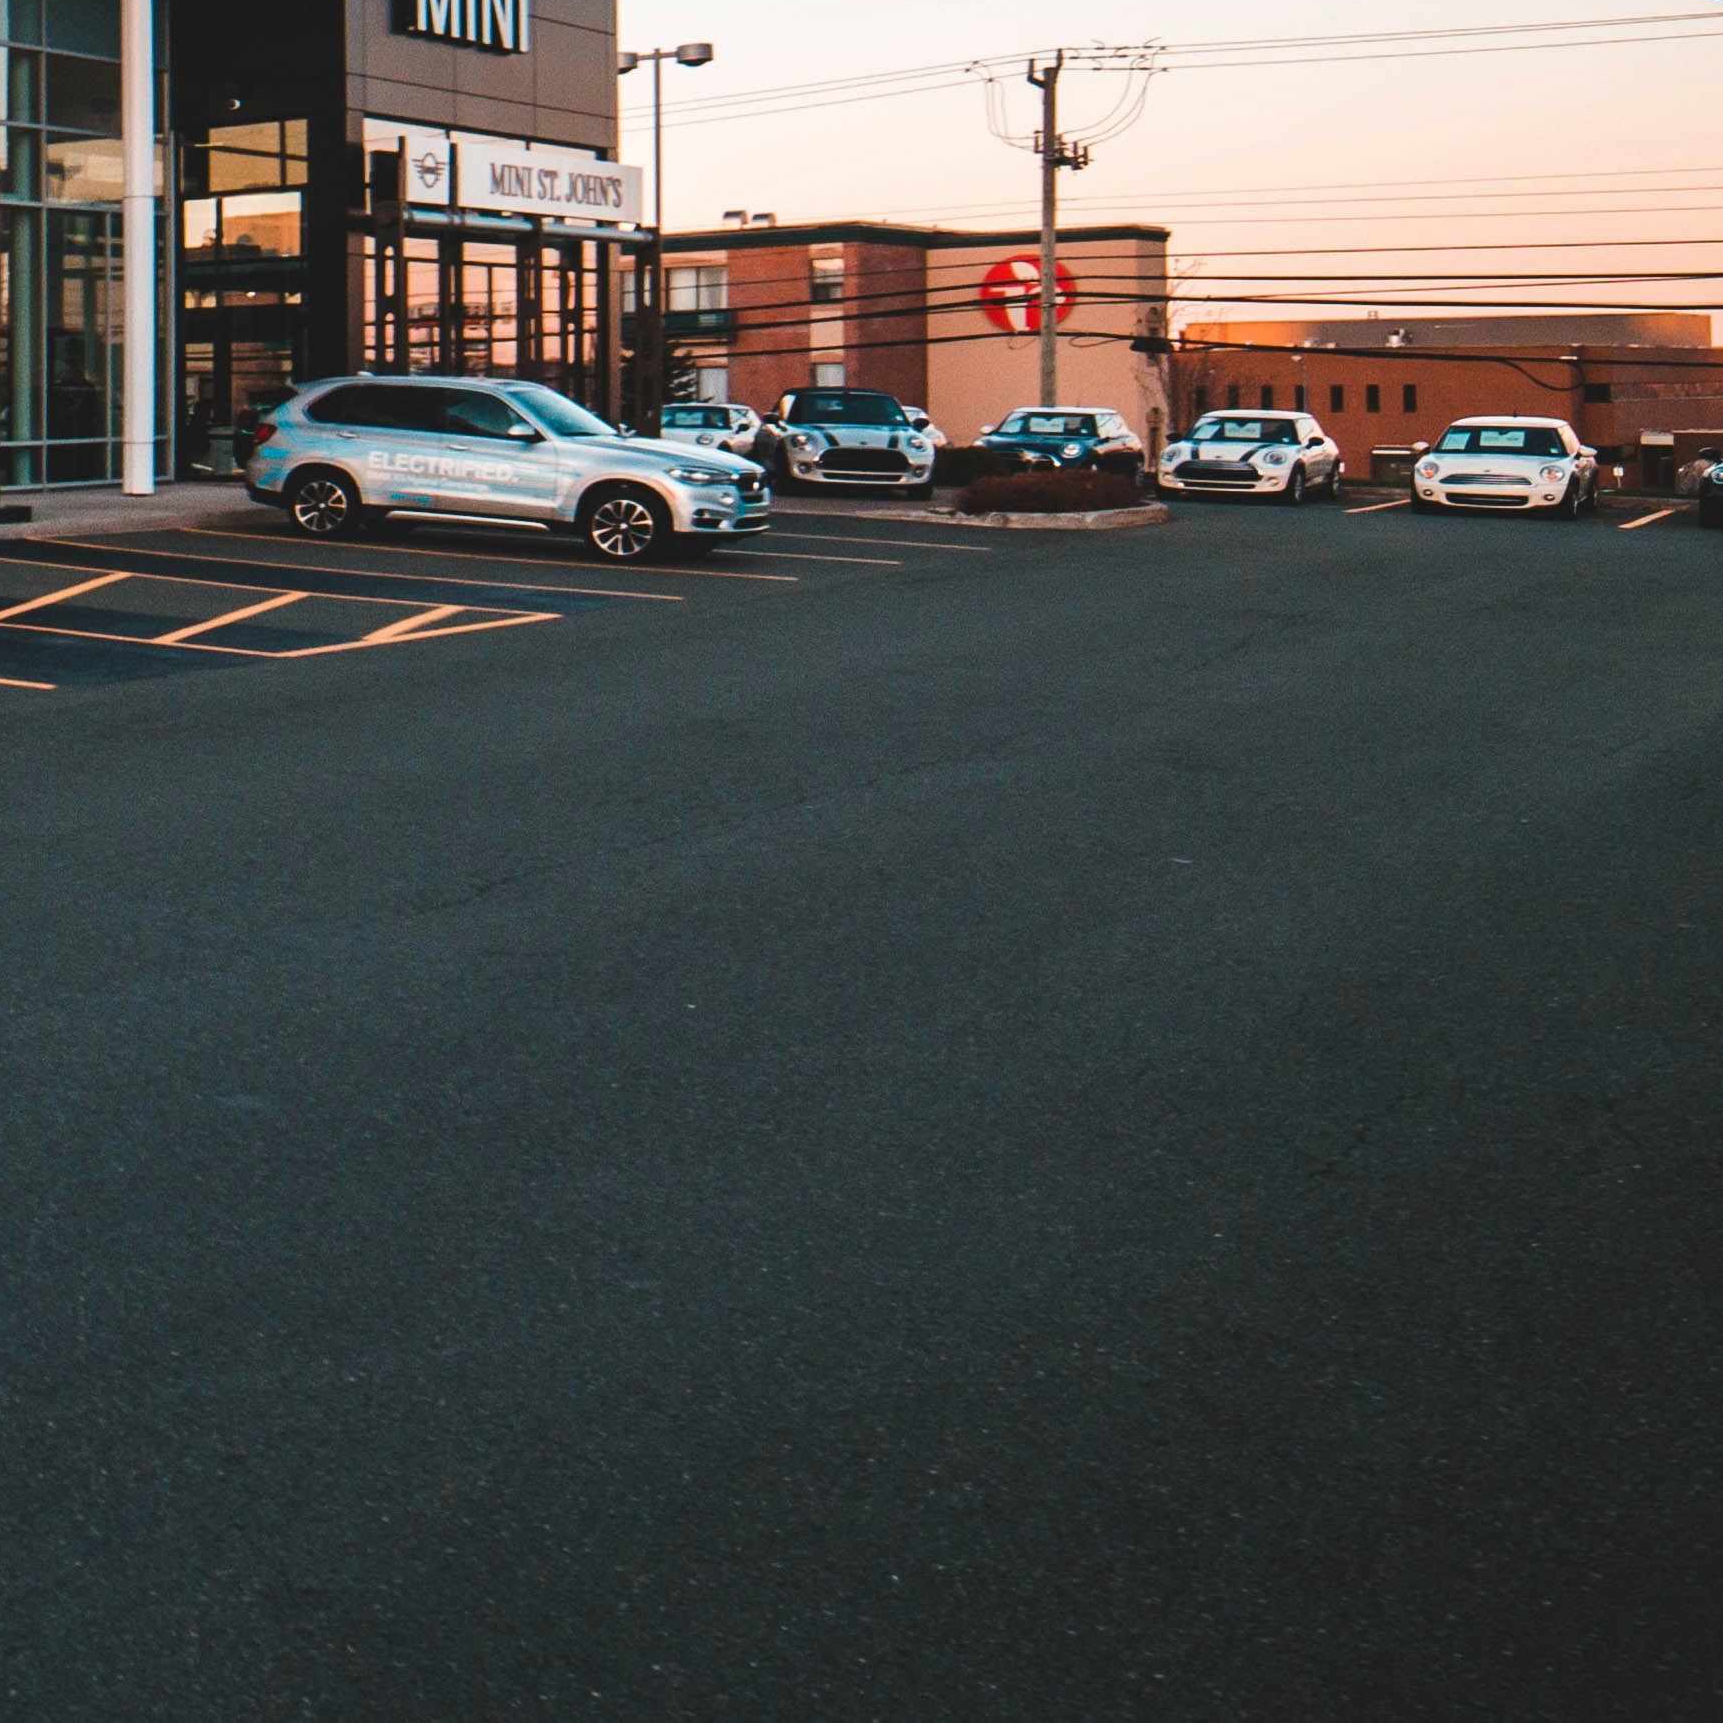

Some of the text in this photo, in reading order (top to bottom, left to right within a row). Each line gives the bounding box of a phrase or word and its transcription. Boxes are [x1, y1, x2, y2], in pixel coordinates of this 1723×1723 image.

[489, 162, 624, 209] MINI ST. JOHN'S
